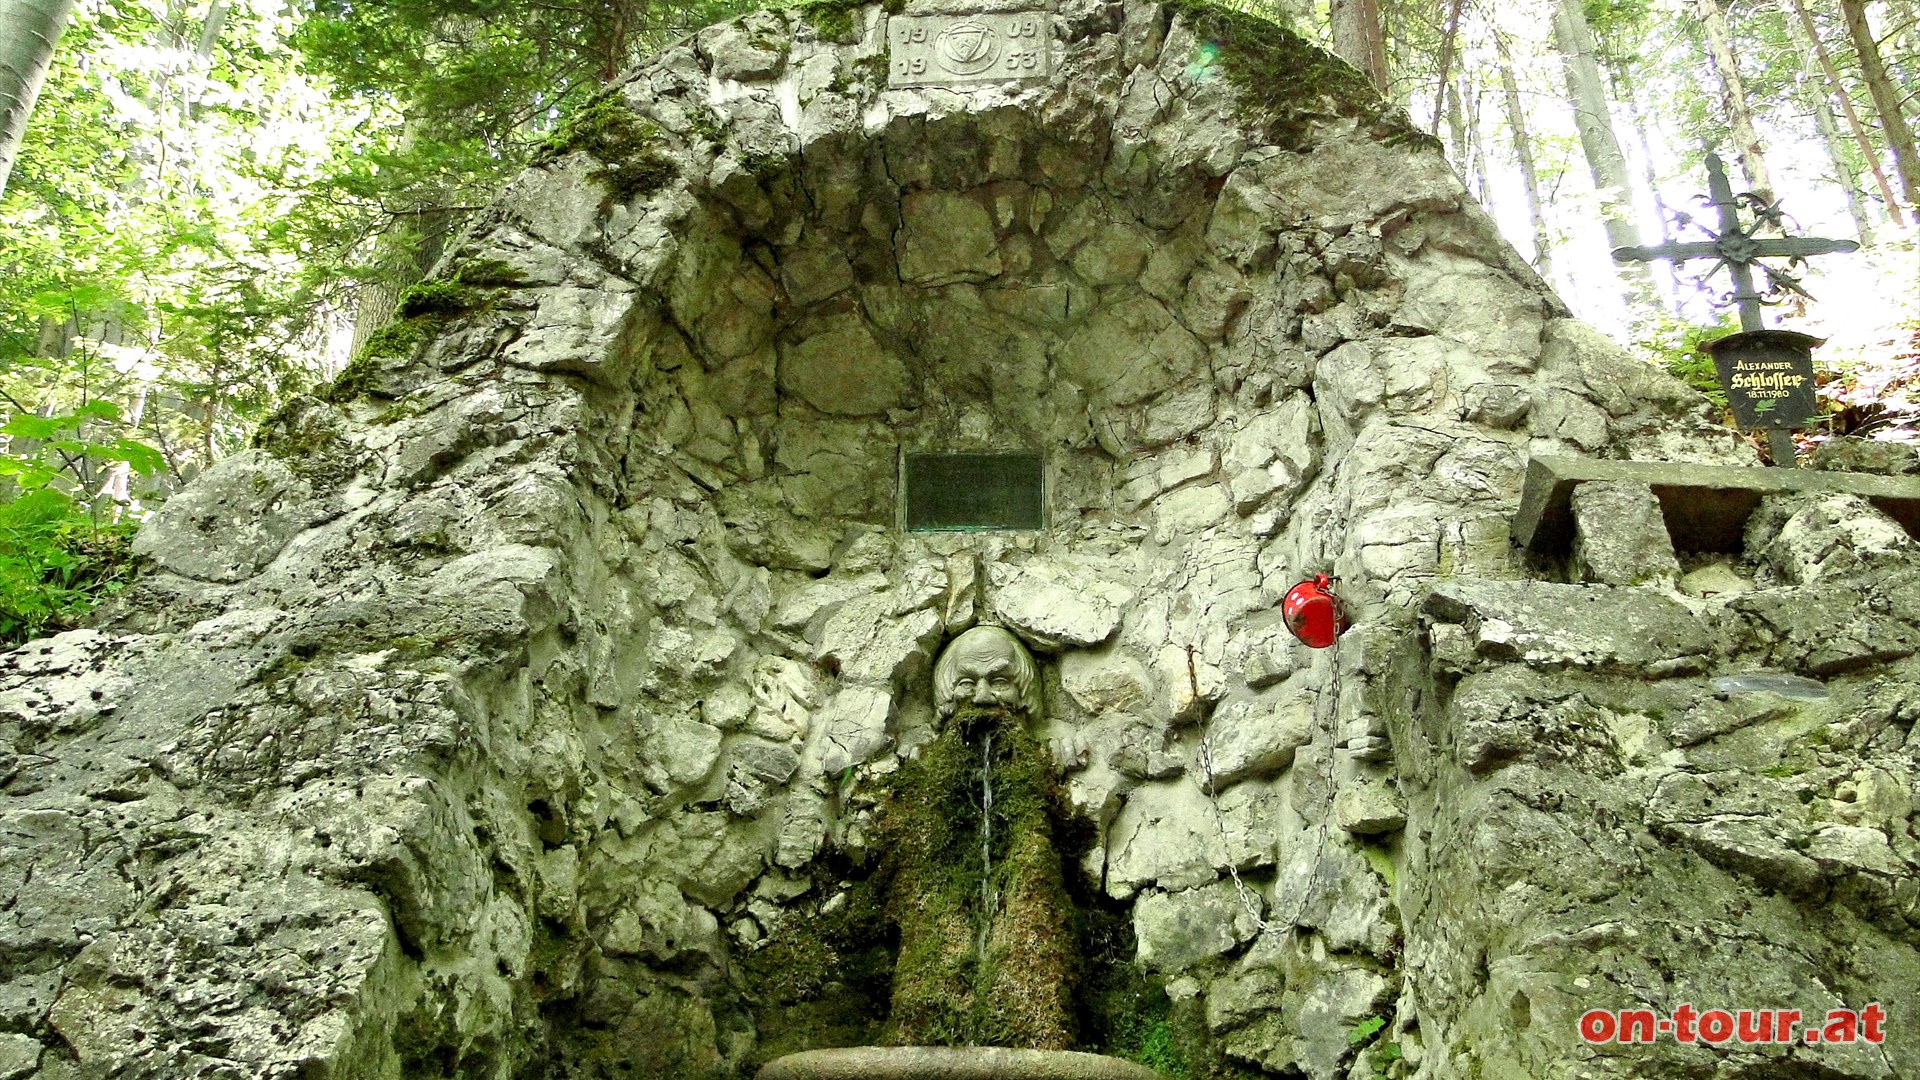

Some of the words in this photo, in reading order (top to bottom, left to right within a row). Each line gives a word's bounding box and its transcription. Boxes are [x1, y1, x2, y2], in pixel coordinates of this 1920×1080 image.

[899, 28, 929, 44] 19
[1006, 20, 1037, 38] 09
[898, 57, 928, 76] 19
[1732, 359, 1793, 371] ALEXANDER
